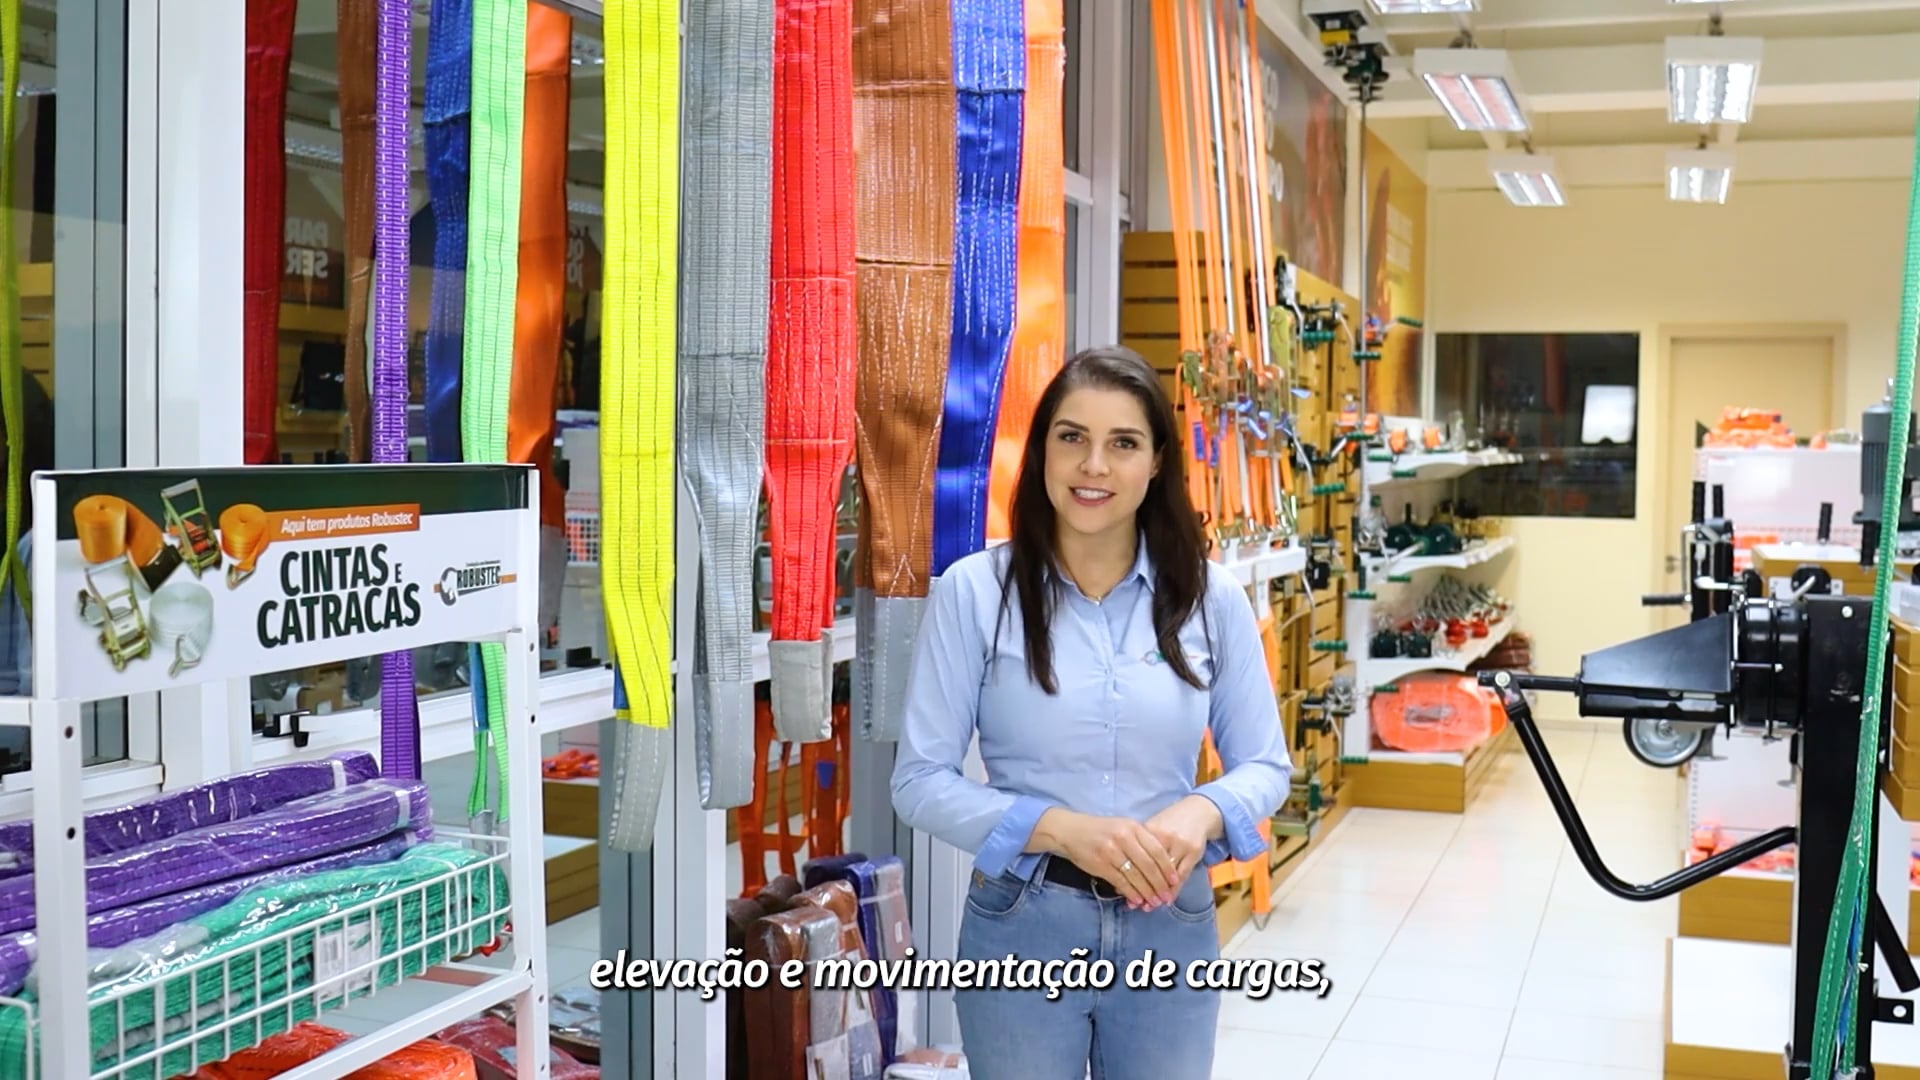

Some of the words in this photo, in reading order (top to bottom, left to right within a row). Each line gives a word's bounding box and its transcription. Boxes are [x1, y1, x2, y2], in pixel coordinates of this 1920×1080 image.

[281, 516, 305, 536] Aqui
[307, 518, 326, 531] tem
[327, 514, 370, 534] produtos
[371, 511, 413, 527] Robustec
[280, 543, 389, 596] CINTAS
[395, 563, 402, 583] E
[457, 565, 501, 588] ROBUSTEC
[257, 583, 421, 648] CATRACAS
